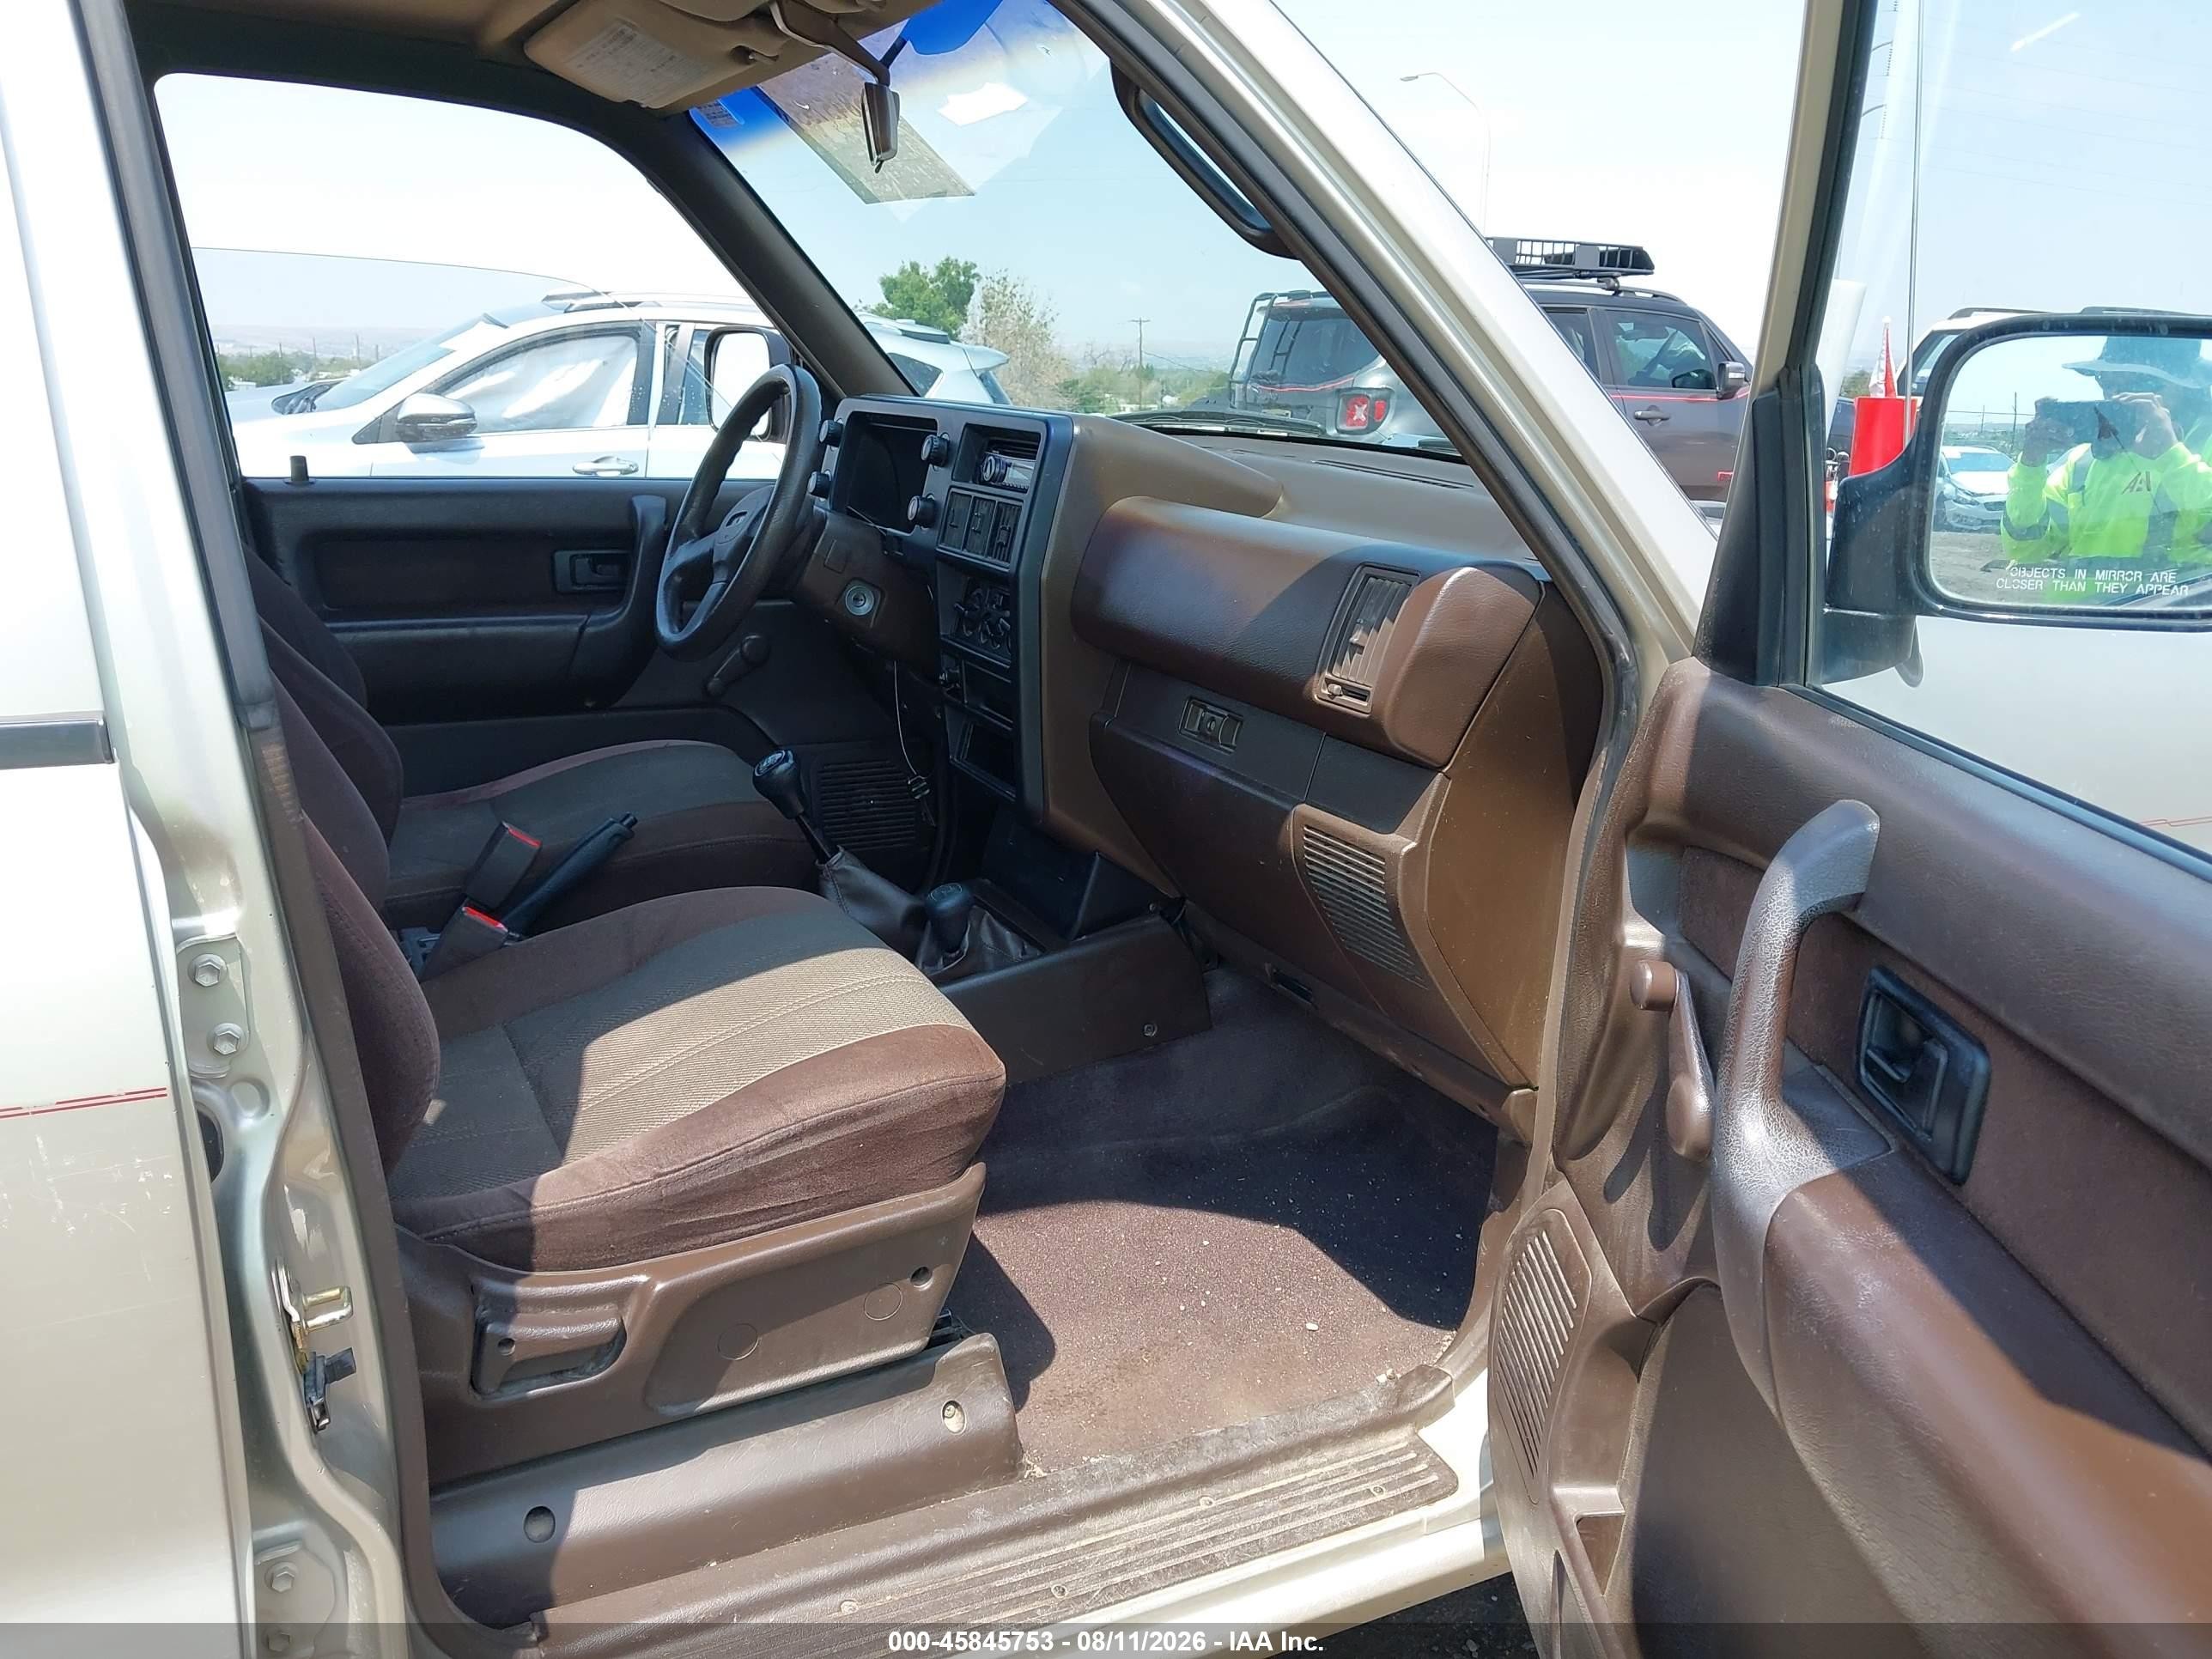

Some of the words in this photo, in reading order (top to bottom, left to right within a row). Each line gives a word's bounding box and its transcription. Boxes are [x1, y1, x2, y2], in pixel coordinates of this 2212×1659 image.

[2009, 567, 2066, 579] OBJECTS
[2075, 568, 2087, 580] IN
[2095, 569, 2142, 582] MIRROR
[2149, 571, 2177, 583] ARE
[1996, 578, 2044, 591] CLOSER
[2053, 580, 2087, 592] THAN
[2094, 581, 2129, 594] THEY
[2136, 583, 2190, 596] APPEAR
